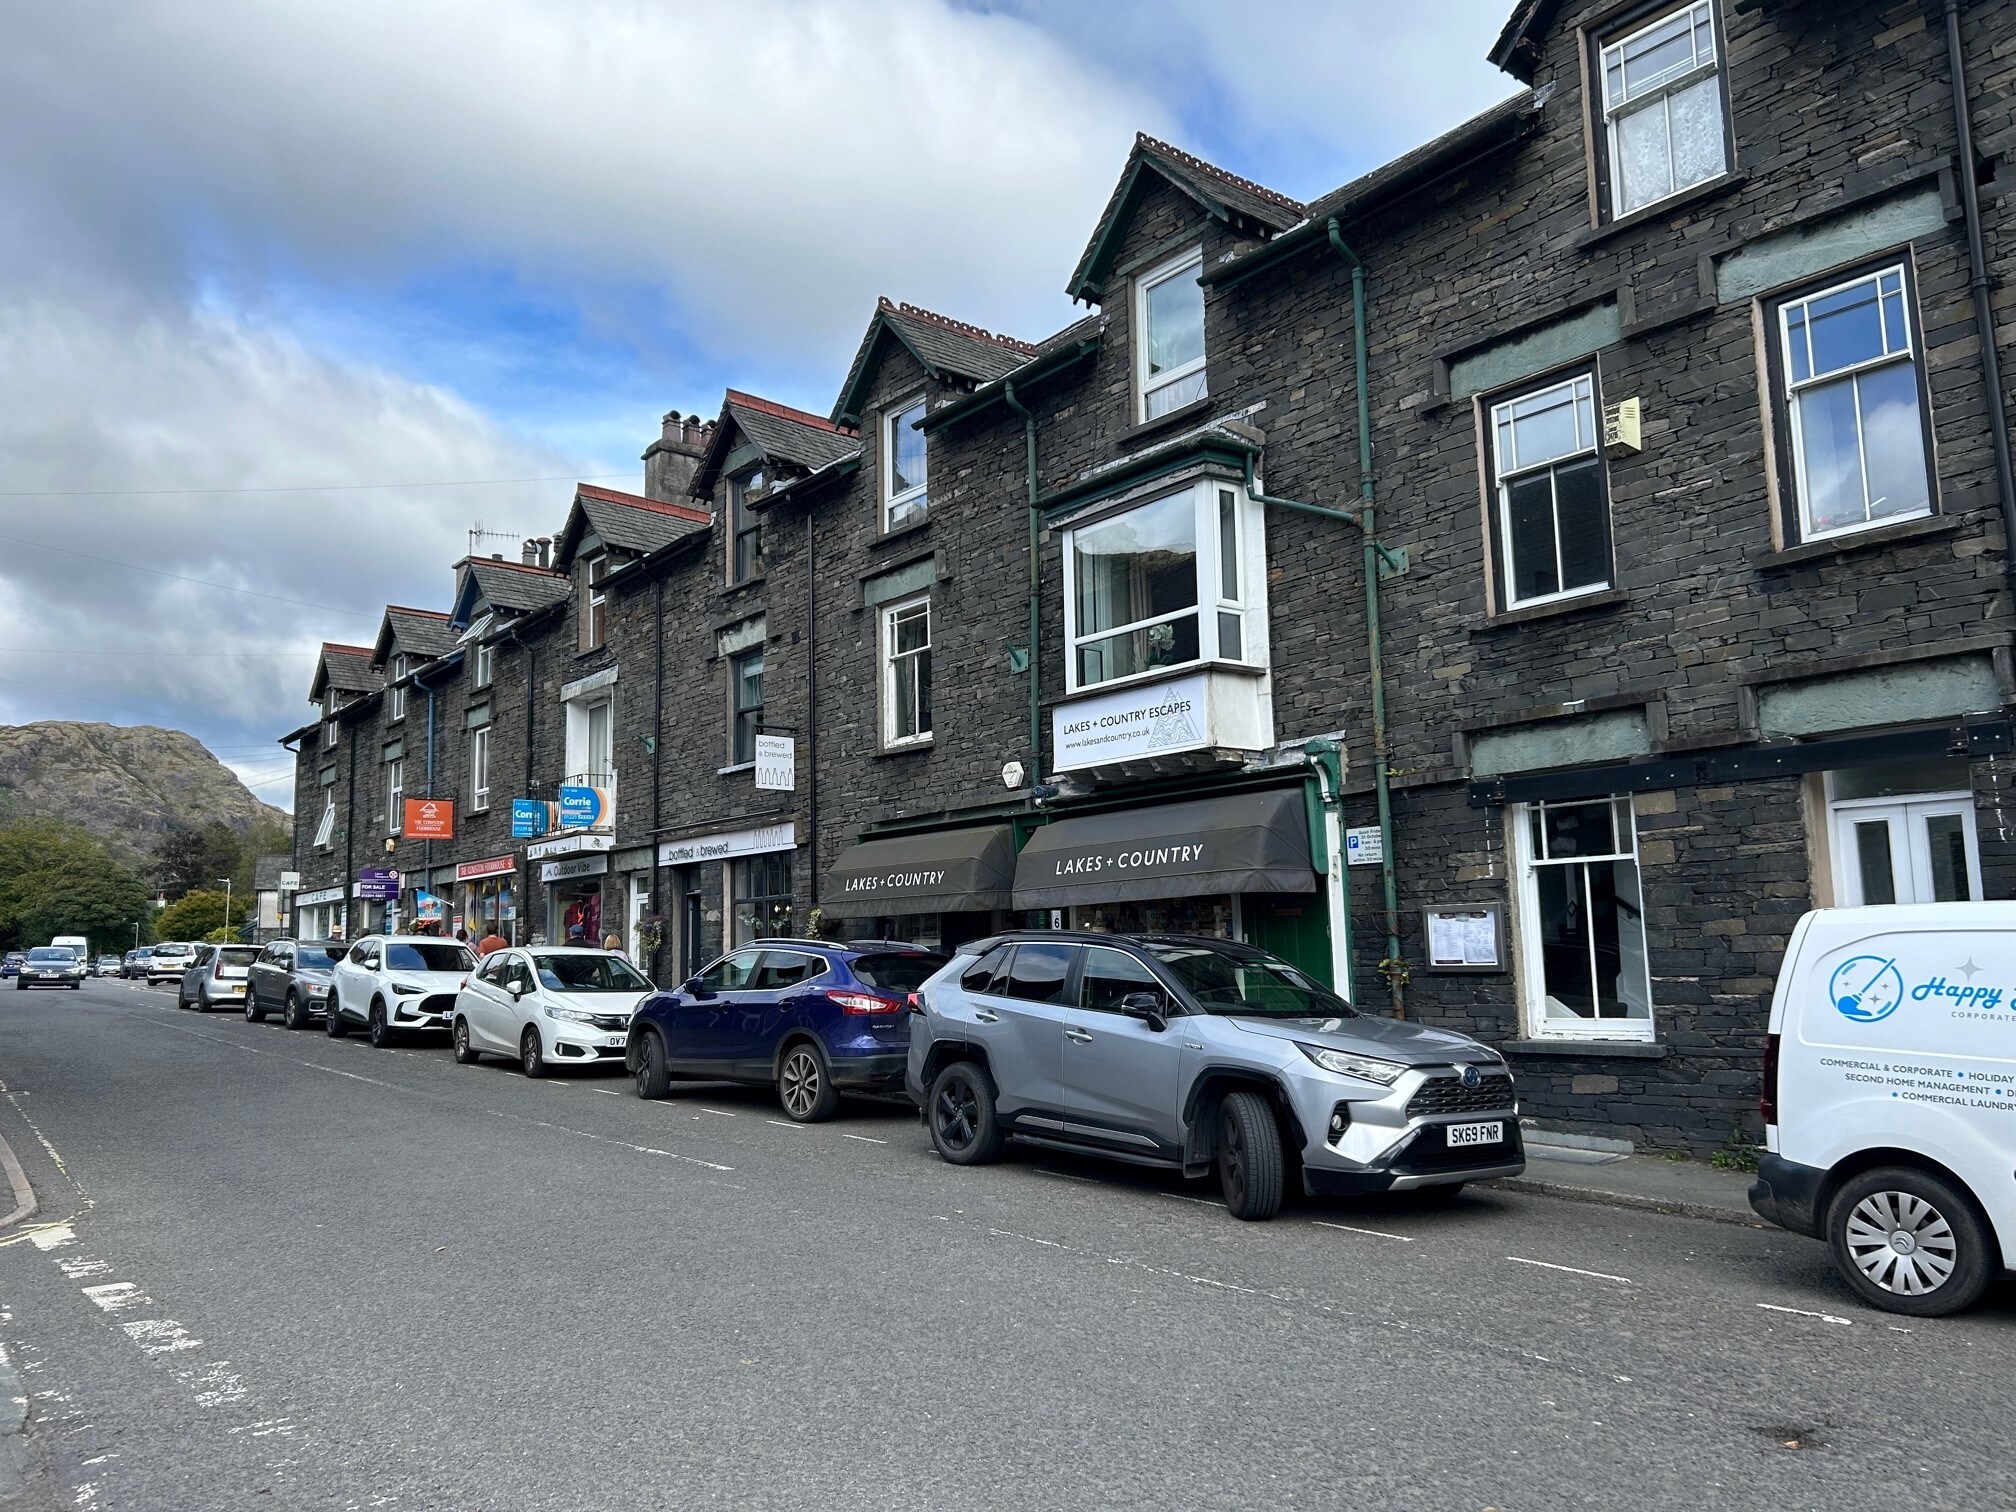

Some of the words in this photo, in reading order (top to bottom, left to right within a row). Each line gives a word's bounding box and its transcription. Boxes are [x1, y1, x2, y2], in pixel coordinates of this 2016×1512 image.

[1063, 720, 1091, 735] LAKES
[1092, 720, 1098, 728] +
[1100, 709, 1147, 728] COUNTRY
[1149, 700, 1191, 719] ESCAPES
[758, 740, 785, 749] bottled
[1065, 727, 1150, 749] www.lakesandcountry.co.uk
[764, 750, 792, 759] brewed
[563, 796, 592, 806] Corrie
[1350, 837, 1357, 848] P
[668, 846, 694, 860] bottled
[700, 841, 729, 856] brewed
[1055, 855, 1103, 875] LAKES
[1106, 857, 1114, 867] +
[1117, 843, 1204, 868] COUNTRY
[553, 864, 577, 876] Outdoor
[577, 862, 591, 873] Vibe
[844, 876, 878, 892] LAKES
[880, 878, 886, 887] +
[886, 870, 945, 887] COUNTRY
[311, 890, 327, 902] CAFE
[1054, 917, 1060, 929] 6
[1911, 976, 2003, 1009] Happy
[1951, 1011, 2016, 1022] CORPORATE
[609, 1037, 626, 1046] OV7
[1820, 1058, 1881, 1071] COMMERCIAL
[1883, 1064, 1891, 1072] &
[1892, 1065, 1953, 1078] CORPORATE
[1968, 1072, 2015, 1084] HOLIDAY
[1844, 1073, 1884, 1084] SECOND
[1886, 1077, 1916, 1087] HOME
[1917, 1080, 1991, 1095] MANAGEMENT
[1902, 1091, 1968, 1106] COMMERCIAL
[1452, 1126, 1478, 1144] SK69
[1480, 1124, 1499, 1141] FNR
